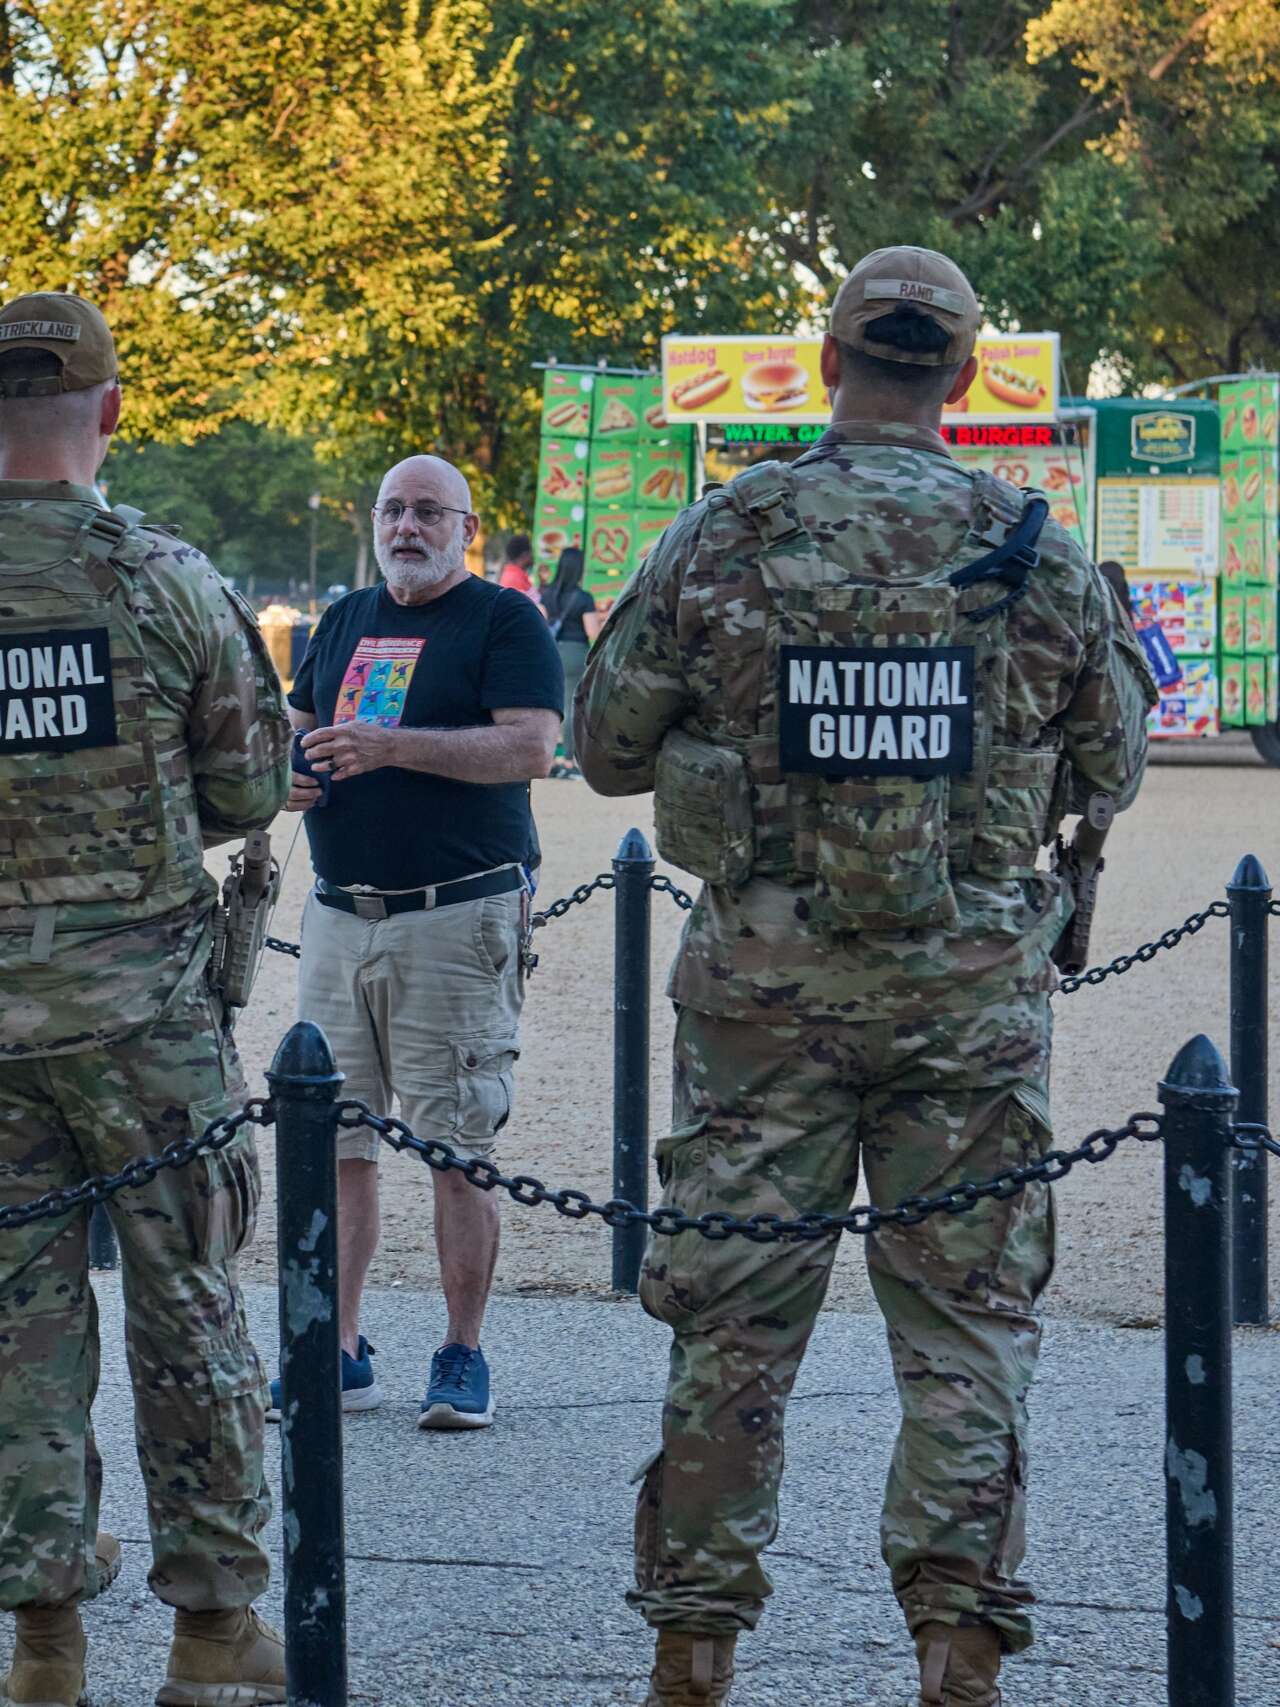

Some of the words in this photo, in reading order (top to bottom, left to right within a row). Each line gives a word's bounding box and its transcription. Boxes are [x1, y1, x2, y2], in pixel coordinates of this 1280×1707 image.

[956, 426, 1052, 447] BURGER
[789, 659, 968, 707] NATIONAL
[809, 713, 952, 760] GUARD
